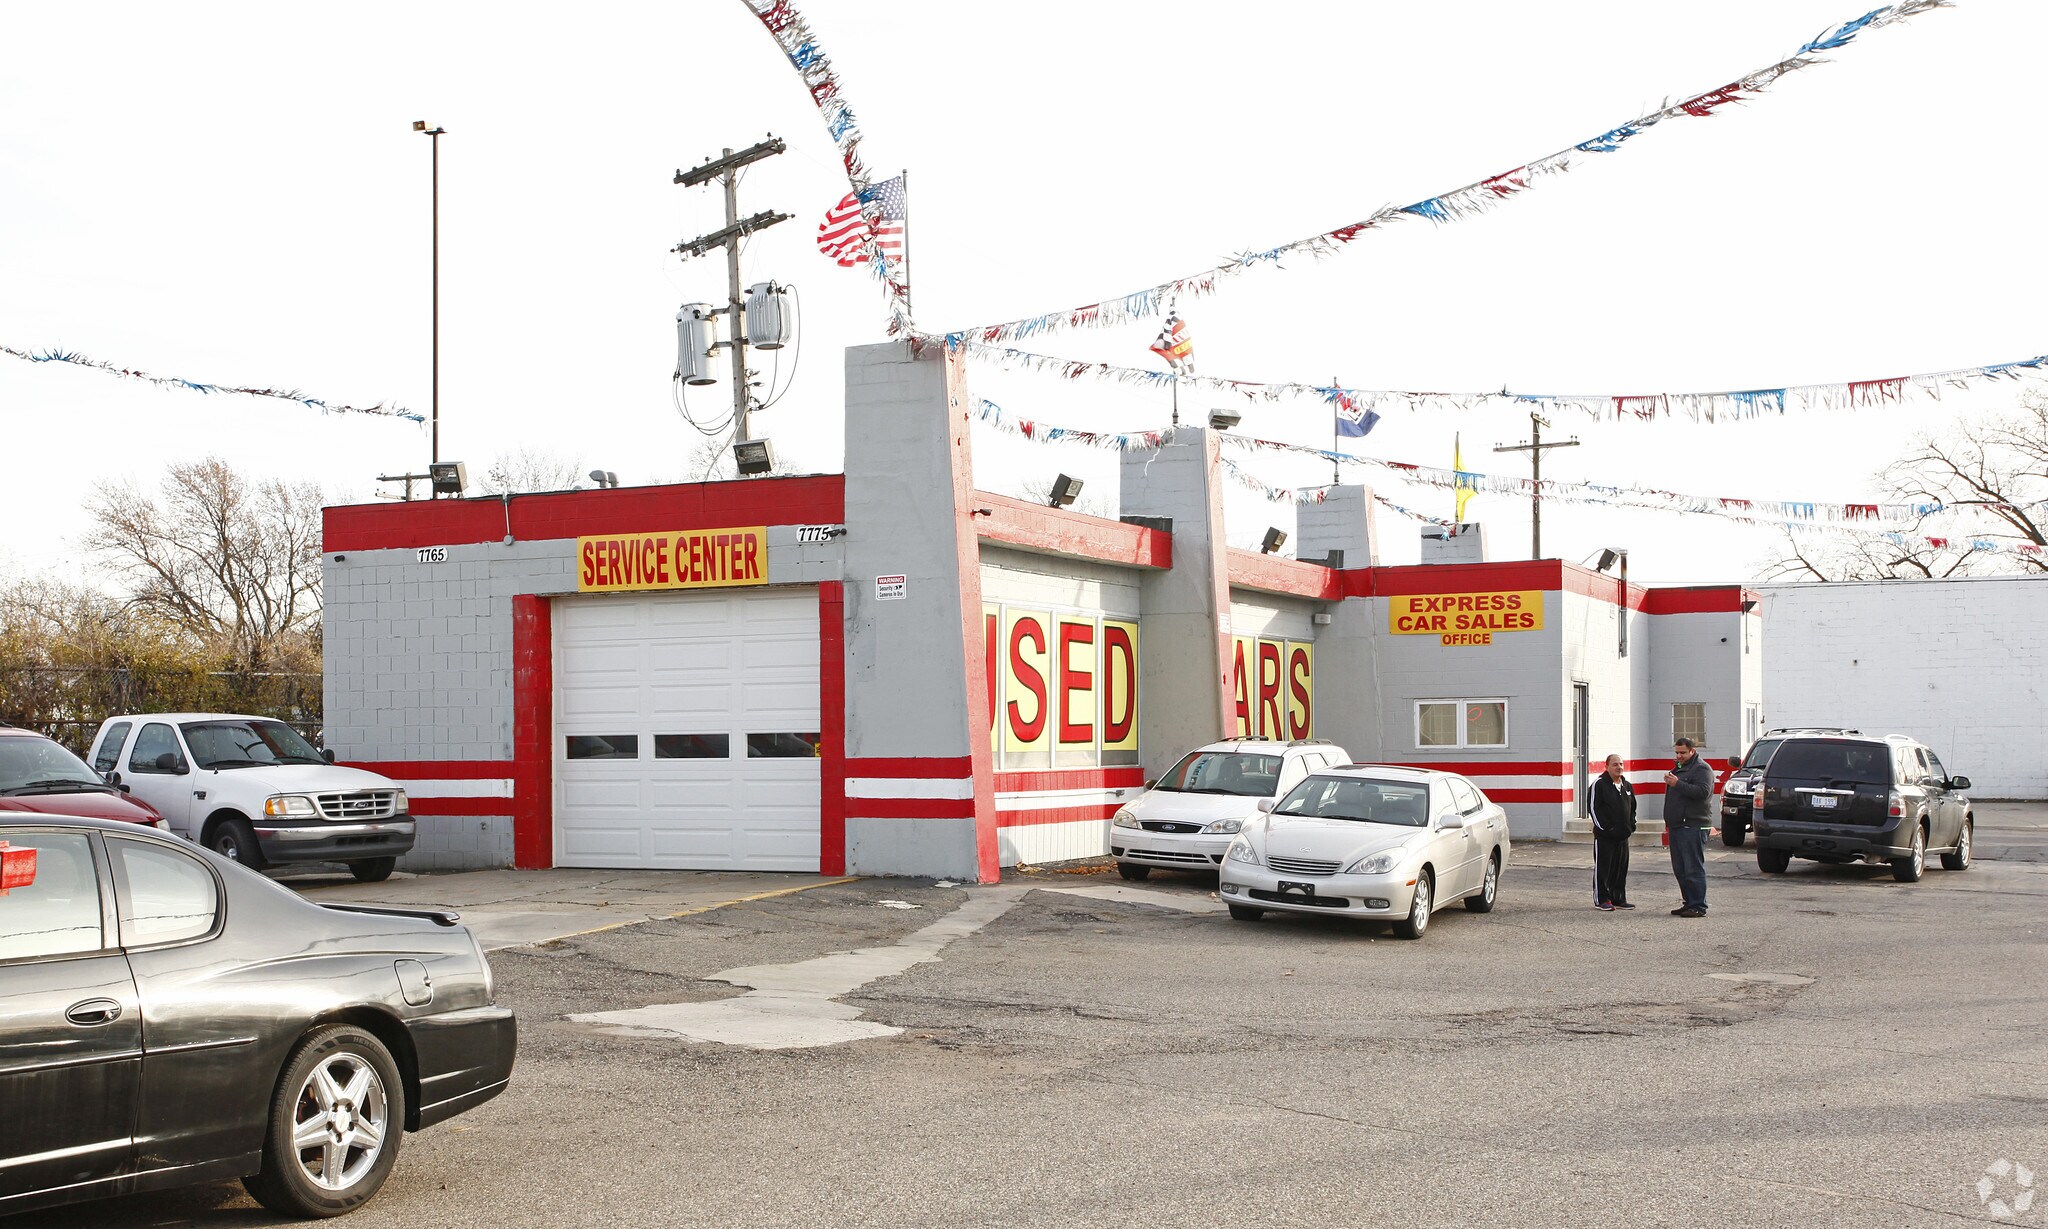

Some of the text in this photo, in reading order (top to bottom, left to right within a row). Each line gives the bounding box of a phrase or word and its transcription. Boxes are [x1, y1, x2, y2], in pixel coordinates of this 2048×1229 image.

[799, 526, 829, 541] 7775
[418, 548, 444, 562] 7765
[583, 533, 759, 586] SERVICE CENTER
[1409, 595, 1521, 613] EXPRESS
[1397, 613, 1534, 631] CAR SALES
[1442, 633, 1491, 645] OFFICE
